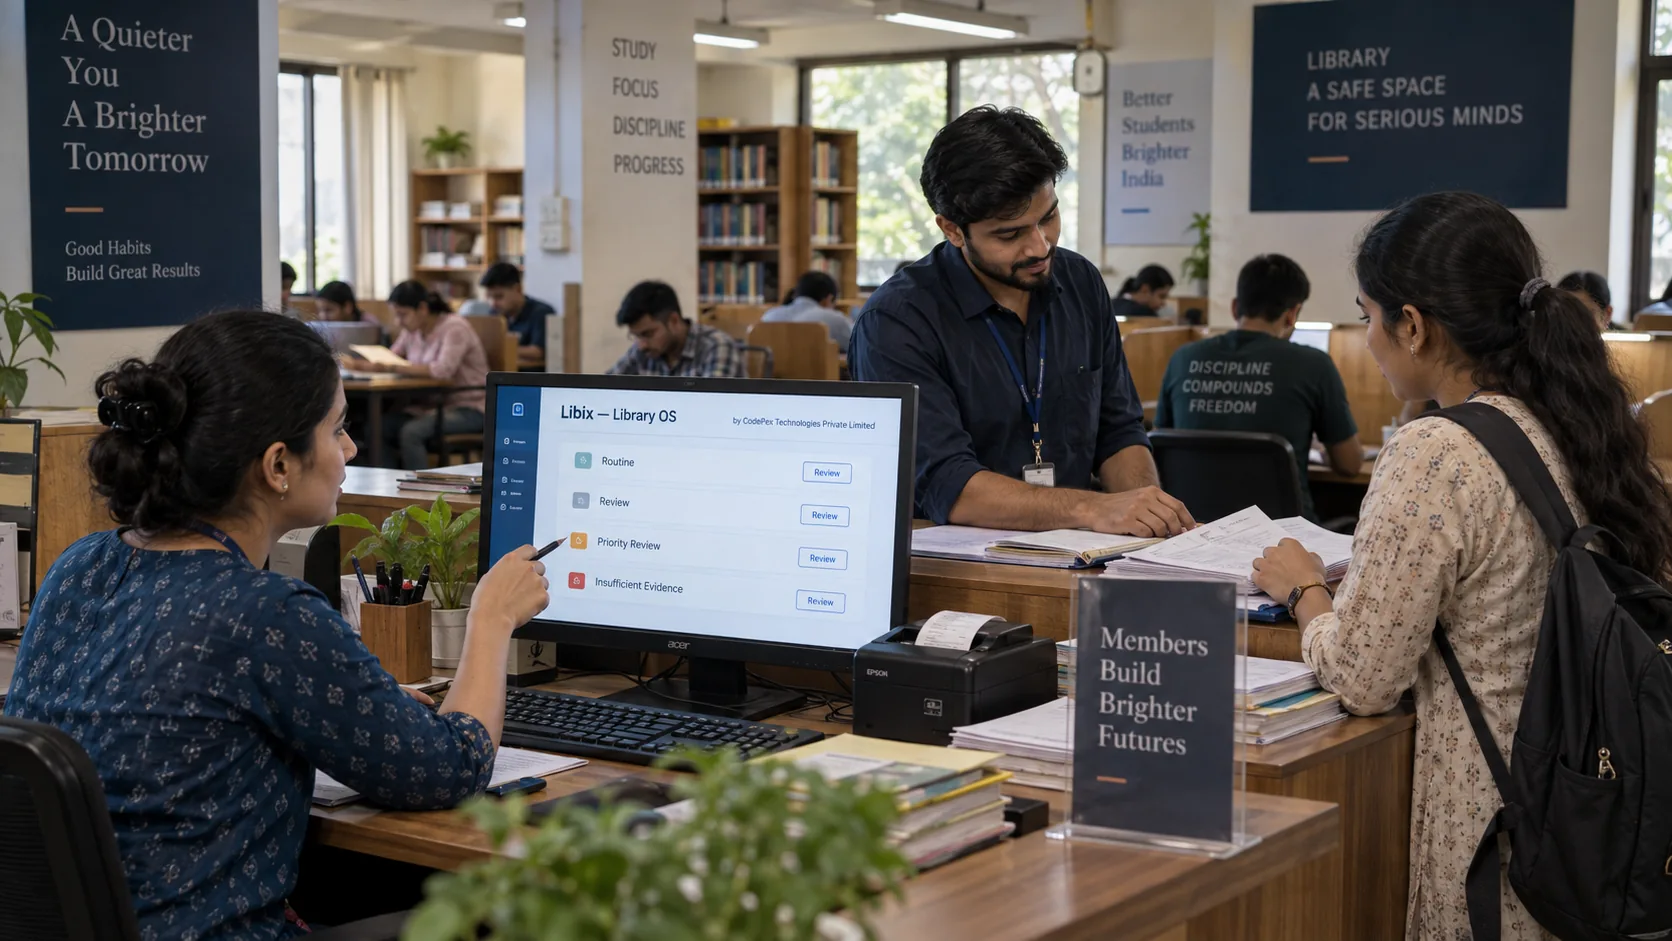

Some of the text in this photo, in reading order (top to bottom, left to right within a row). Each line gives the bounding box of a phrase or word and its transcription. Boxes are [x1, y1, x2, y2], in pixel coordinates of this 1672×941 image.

[61, 14, 192, 52] A Quieter
[612, 37, 656, 59] STUDY
[1308, 47, 1390, 70] LIBRARY
[62, 56, 119, 87] You
[613, 77, 658, 98] FOCUS
[1307, 76, 1445, 100] A SAFE SPACE
[1123, 90, 1173, 107] Better
[63, 100, 206, 138] A Brighter
[613, 116, 685, 138] DISCIPLINE
[1123, 115, 1195, 134] Students
[1308, 104, 1522, 131] FOR SERIOUS MINDS
[64, 142, 208, 172] Tomorrow
[1123, 142, 1191, 164] Brighter
[614, 154, 684, 175] PROGRESS
[1122, 169, 1164, 187] India
[66, 240, 151, 256] Good Habits
[67, 262, 200, 281] Build Great Results
[1189, 360, 1271, 375] DISCIPLINE
[1182, 379, 1273, 395] COMPOUNDS
[561, 404, 594, 420] Libix
[613, 407, 655, 424] Library
[659, 410, 677, 423] OS
[1189, 399, 1257, 413] FREEDOM
[733, 416, 742, 426] by
[775, 417, 821, 429] Technologies
[822, 419, 847, 429] Private
[849, 420, 876, 430] Limited
[602, 457, 634, 466] Routine
[815, 469, 840, 477] Review
[600, 497, 629, 506] Review
[813, 511, 838, 519] Review
[598, 537, 660, 550] Priority Review
[810, 554, 835, 563] Review
[595, 577, 683, 593] Insufficient Evidence
[808, 597, 833, 606] Review
[668, 641, 690, 649] acer
[1101, 627, 1208, 656] Members
[1101, 659, 1160, 685] Build
[1099, 693, 1197, 725] Brighter
[1099, 722, 1186, 754] Futures
